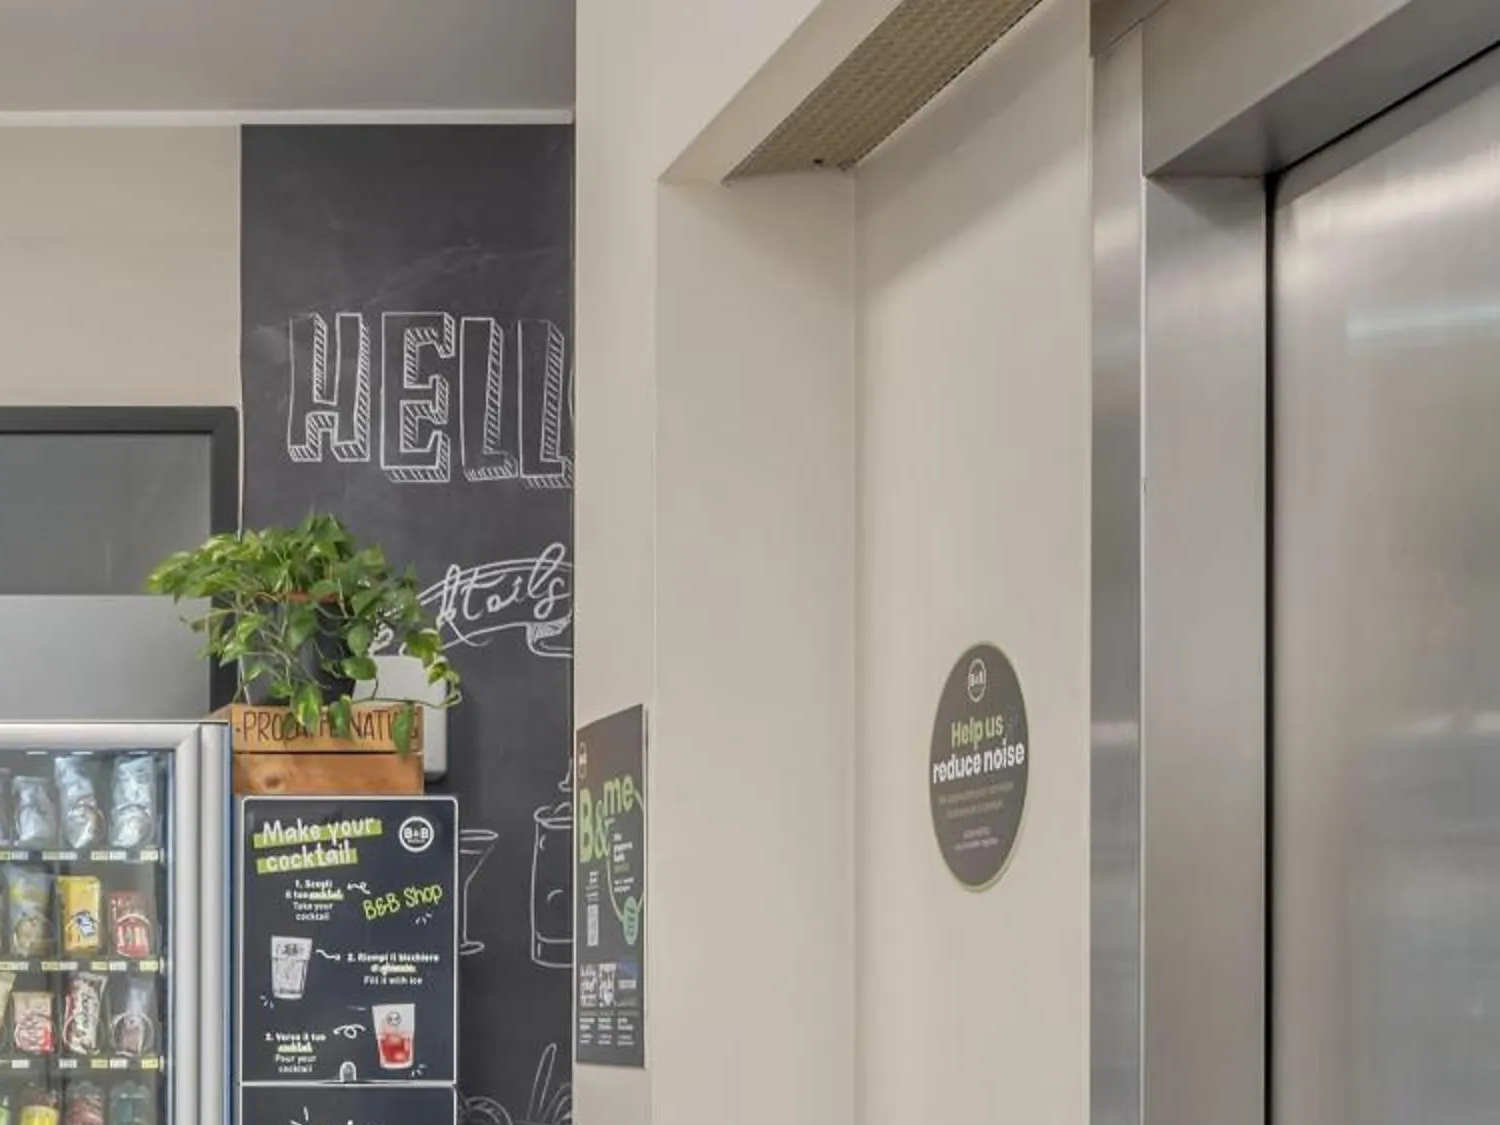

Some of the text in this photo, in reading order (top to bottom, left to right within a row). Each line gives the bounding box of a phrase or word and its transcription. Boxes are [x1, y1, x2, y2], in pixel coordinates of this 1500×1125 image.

[287, 312, 573, 489] HELL
[951, 714, 1004, 749] Help us
[933, 740, 1025, 784] reduce noise
[263, 817, 373, 845] Make your
[265, 839, 351, 872] cocktail
[404, 883, 443, 908] Shop
[295, 911, 330, 921] cocktail
